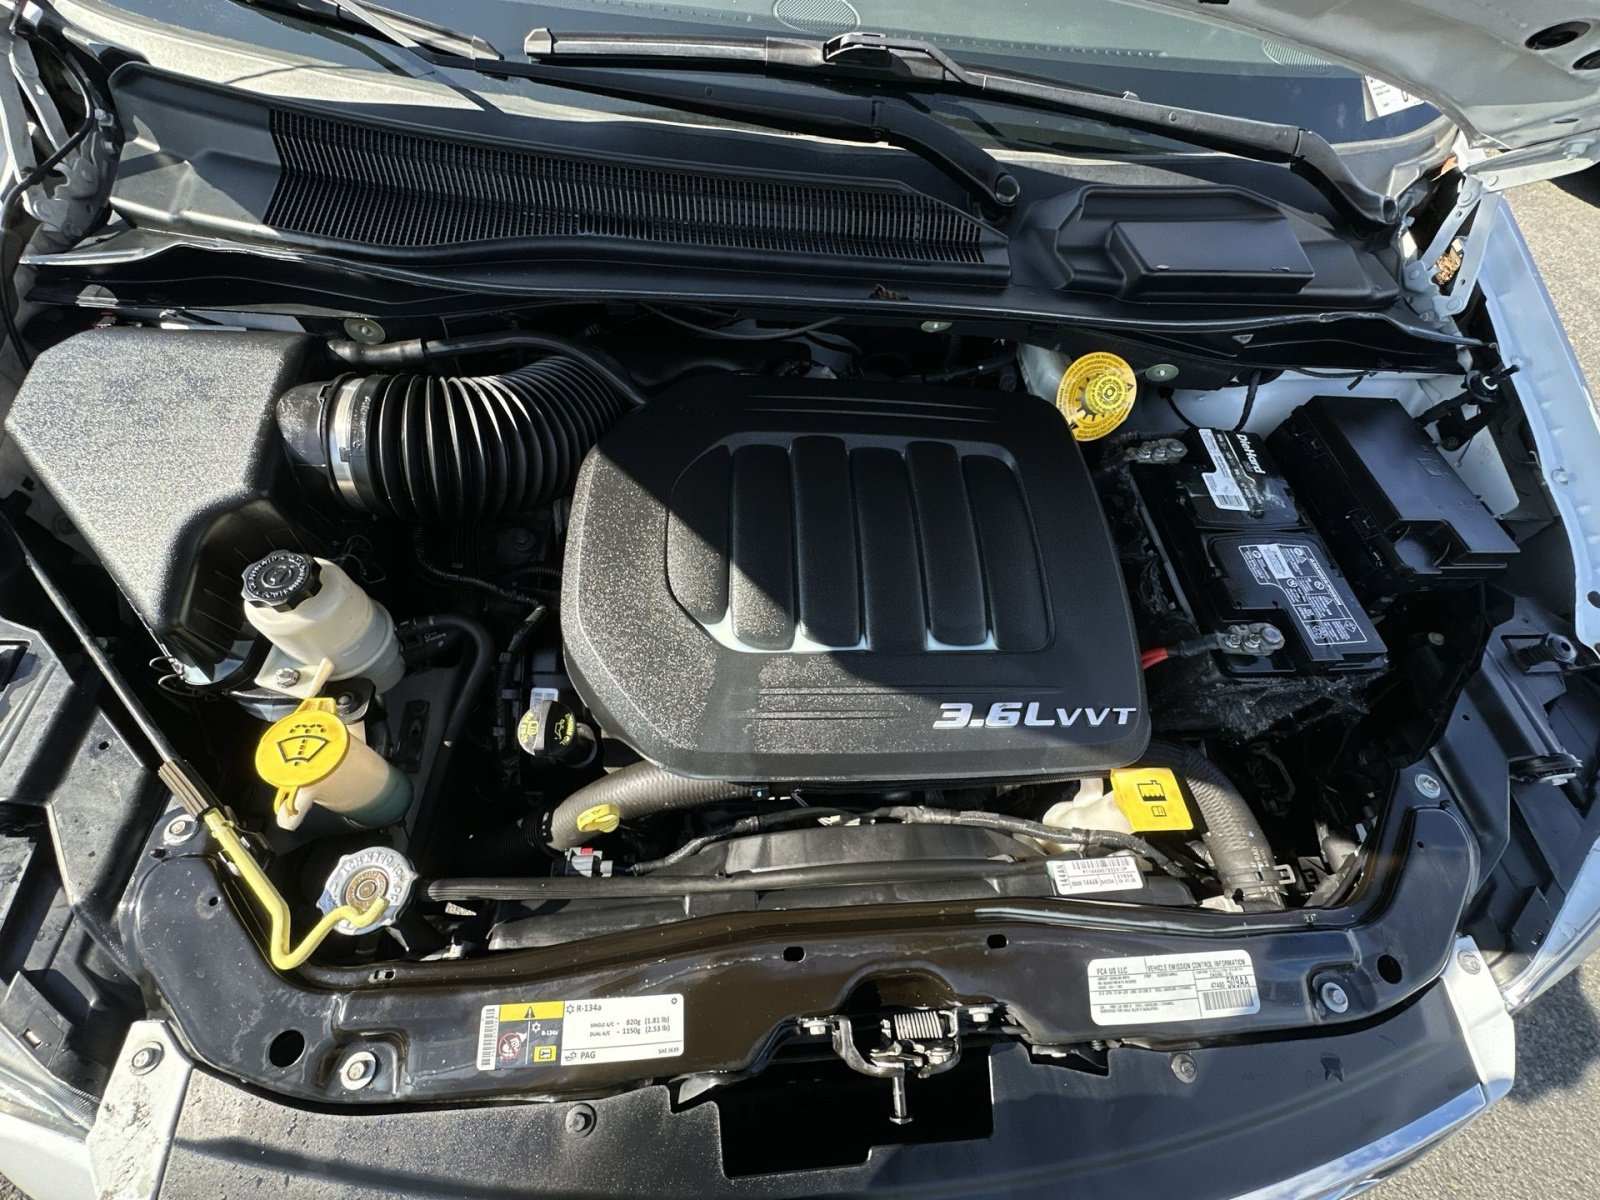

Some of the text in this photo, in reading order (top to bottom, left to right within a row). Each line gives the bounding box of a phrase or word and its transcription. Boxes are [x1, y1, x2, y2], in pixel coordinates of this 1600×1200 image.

[1236, 434, 1266, 474] DieHard
[1148, 959, 1246, 972] VEHICLE EMISSION CONTROL INFORMATION
[1097, 966, 1128, 975] FCA US LLC
[576, 1004, 602, 1012] R-134a
[644, 1017, 660, 1025] (1.81
[661, 1016, 670, 1024] lb)
[622, 1027, 641, 1035] 1150g
[645, 1025, 660, 1034] (2.53
[661, 1024, 671, 1032] lb)
[580, 1051, 596, 1060] PAG
